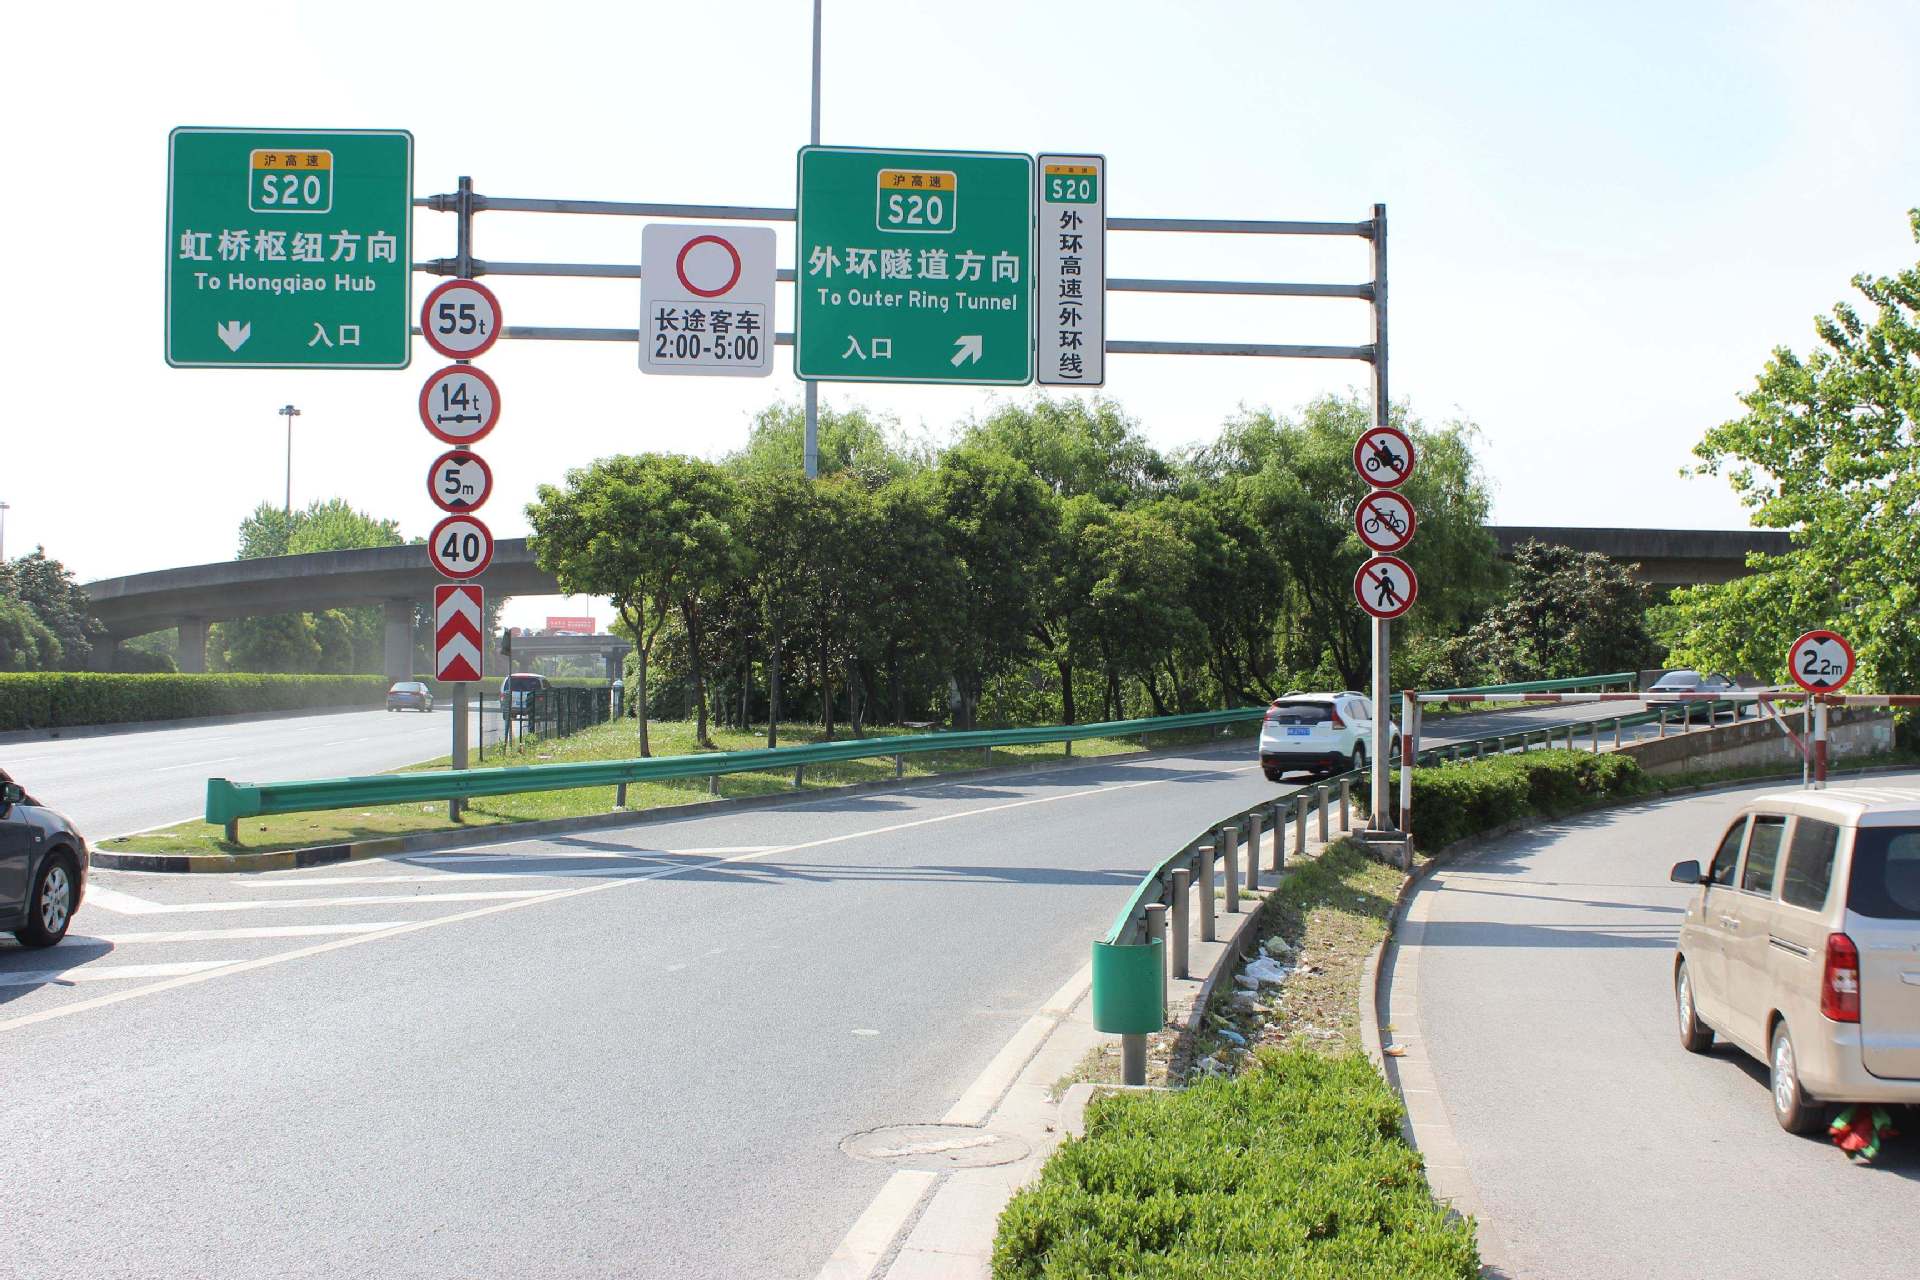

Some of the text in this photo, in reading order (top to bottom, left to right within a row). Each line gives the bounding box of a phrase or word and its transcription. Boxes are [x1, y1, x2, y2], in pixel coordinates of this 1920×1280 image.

[264, 154, 319, 167] 沪高速
[261, 174, 321, 205] S20
[893, 175, 941, 188] 沪高速
[1052, 178, 1090, 199] S20
[887, 194, 943, 225] S20
[179, 229, 397, 263] 虹桥枢纽方向
[808, 245, 1020, 283] 外环隧道方向
[194, 272, 376, 295] To Hongqiao Hub
[1058, 210, 1083, 379] 外环高速(外环线)
[817, 288, 1017, 313] To Outer Ring Tunnel
[438, 303, 486, 335] 55t
[655, 307, 761, 334] 长途客车
[307, 322, 361, 348] 入口
[655, 333, 759, 360] 2:00-5:00
[842, 335, 893, 360] 入口
[441, 382, 480, 411] 14t
[445, 469, 475, 496] 5m
[442, 533, 480, 563] 40
